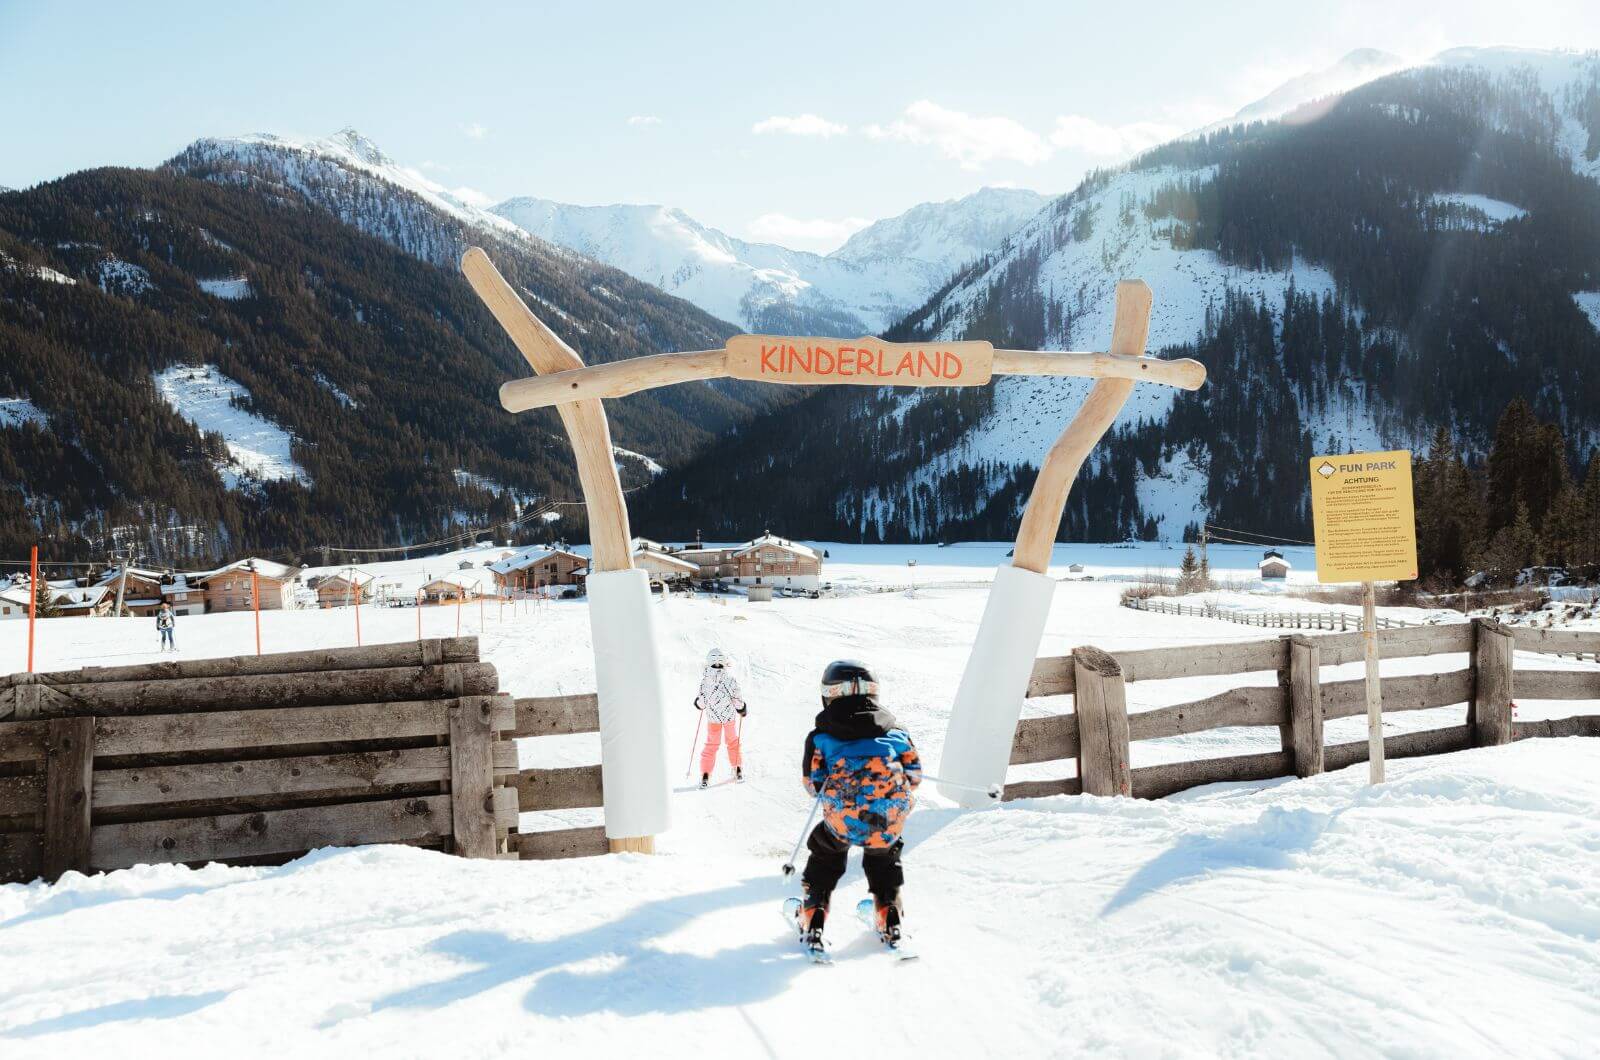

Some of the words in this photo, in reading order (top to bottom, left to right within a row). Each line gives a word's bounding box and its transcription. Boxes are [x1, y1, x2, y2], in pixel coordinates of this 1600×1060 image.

[760, 344, 963, 379] KINDERLAND
[1339, 463, 1363, 473] FUN
[1366, 461, 1396, 471] PARK
[1344, 476, 1380, 485] ACHTUNG
